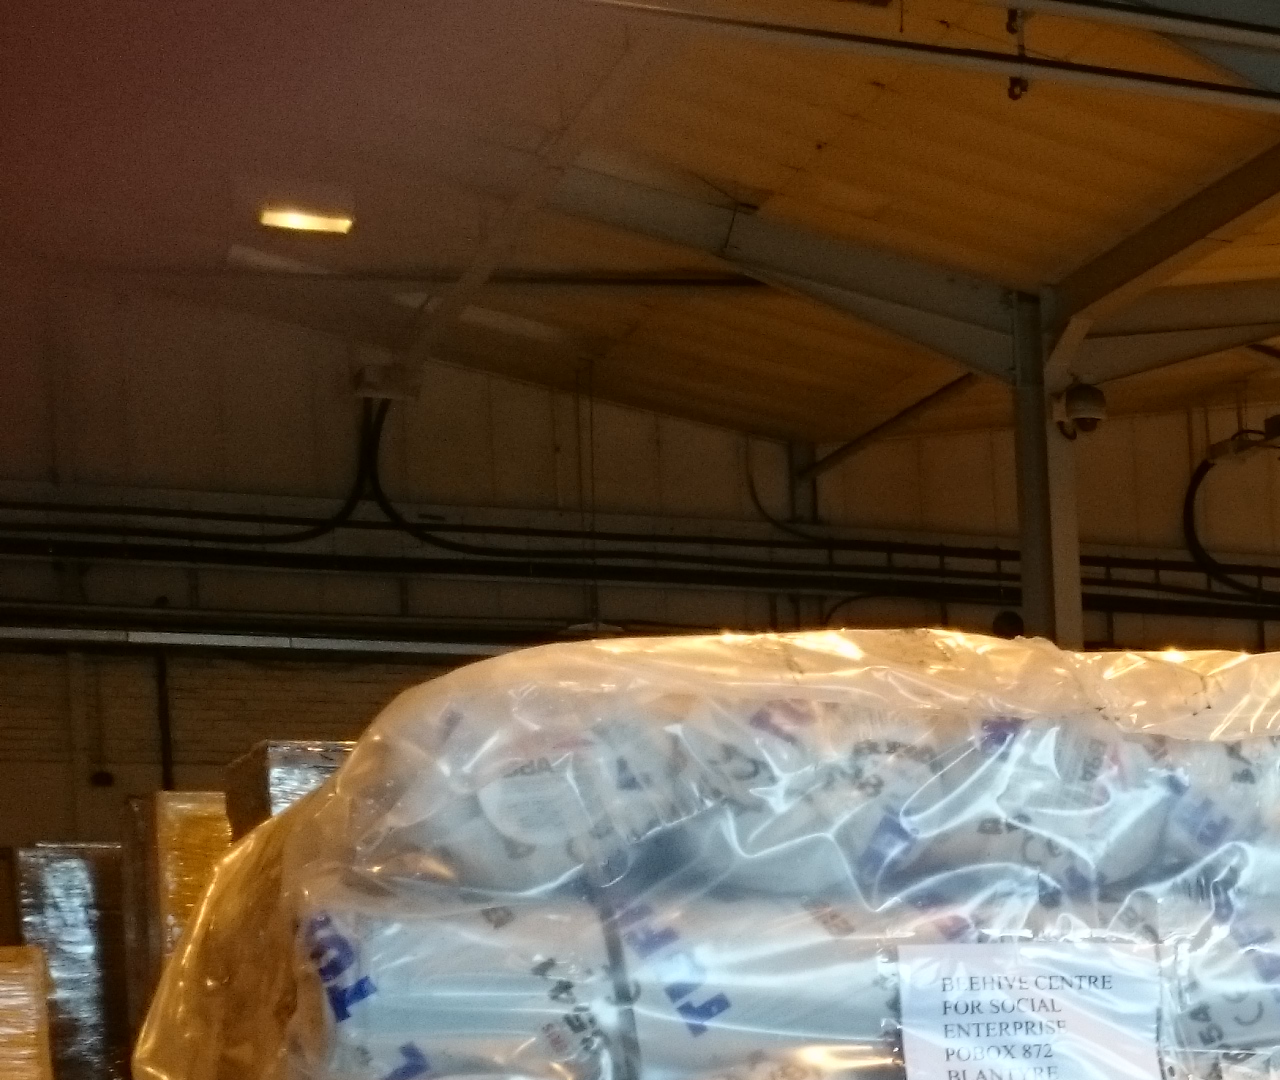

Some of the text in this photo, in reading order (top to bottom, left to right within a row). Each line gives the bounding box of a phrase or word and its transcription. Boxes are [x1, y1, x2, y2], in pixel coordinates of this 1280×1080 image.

[941, 975, 1113, 992] BEEHIVE CENTRE
[942, 998, 1062, 1015] FOR SOCIAL
[943, 1020, 1068, 1039] ENTERPRISE
[944, 1044, 1054, 1062] POBOX 872
